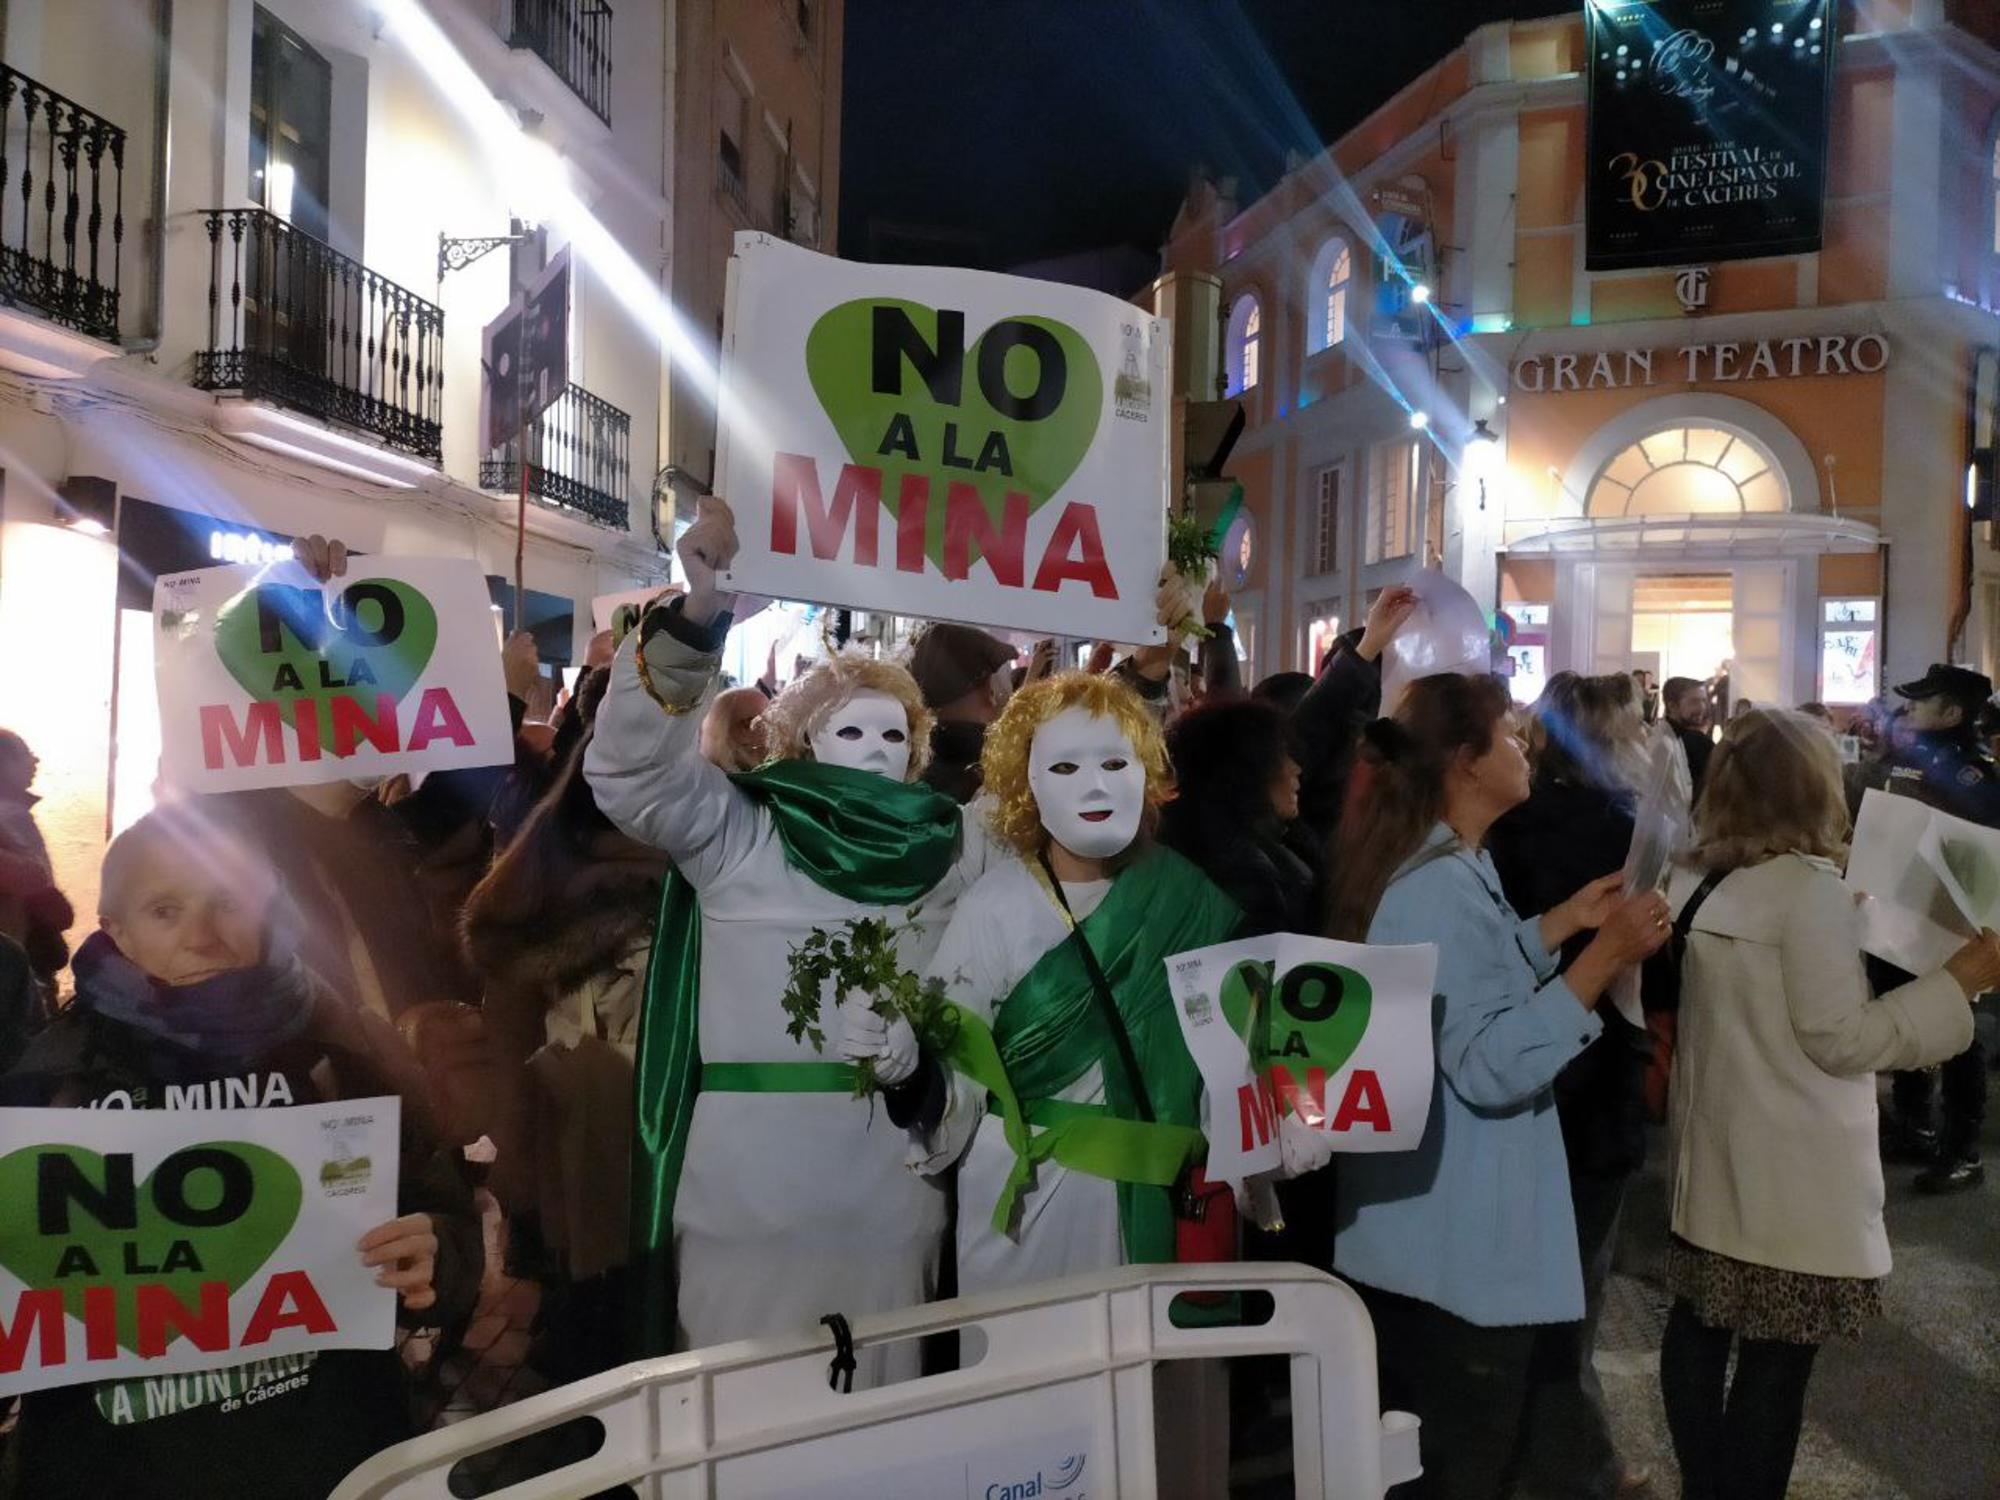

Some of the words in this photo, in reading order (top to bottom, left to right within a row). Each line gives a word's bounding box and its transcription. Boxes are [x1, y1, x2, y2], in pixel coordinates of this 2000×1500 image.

[1671, 147, 1764, 172] FESTIVAL
[1708, 161, 1801, 184] ESPAÑOL
[872, 306, 1067, 422] NO
[1514, 349, 1656, 393] GRAN
[1678, 333, 1890, 382] TEATRO
[877, 412, 921, 461] A
[942, 422, 1013, 477] LA
[771, 451, 1120, 600] MINA
[257, 583, 404, 653] NO
[273, 663, 305, 691] A
[318, 658, 378, 689] LA
[200, 687, 476, 769] MINA
[165, 1072, 295, 1109] MINA
[37, 1147, 254, 1236] NO
[54, 1245, 100, 1278] A
[123, 1240, 204, 1275] LA
[0, 1270, 338, 1374] MINA
[220, 1398, 241, 1414] de
[245, 1374, 310, 1405] Cáceres
[986, 1471, 1042, 1500] Canal
